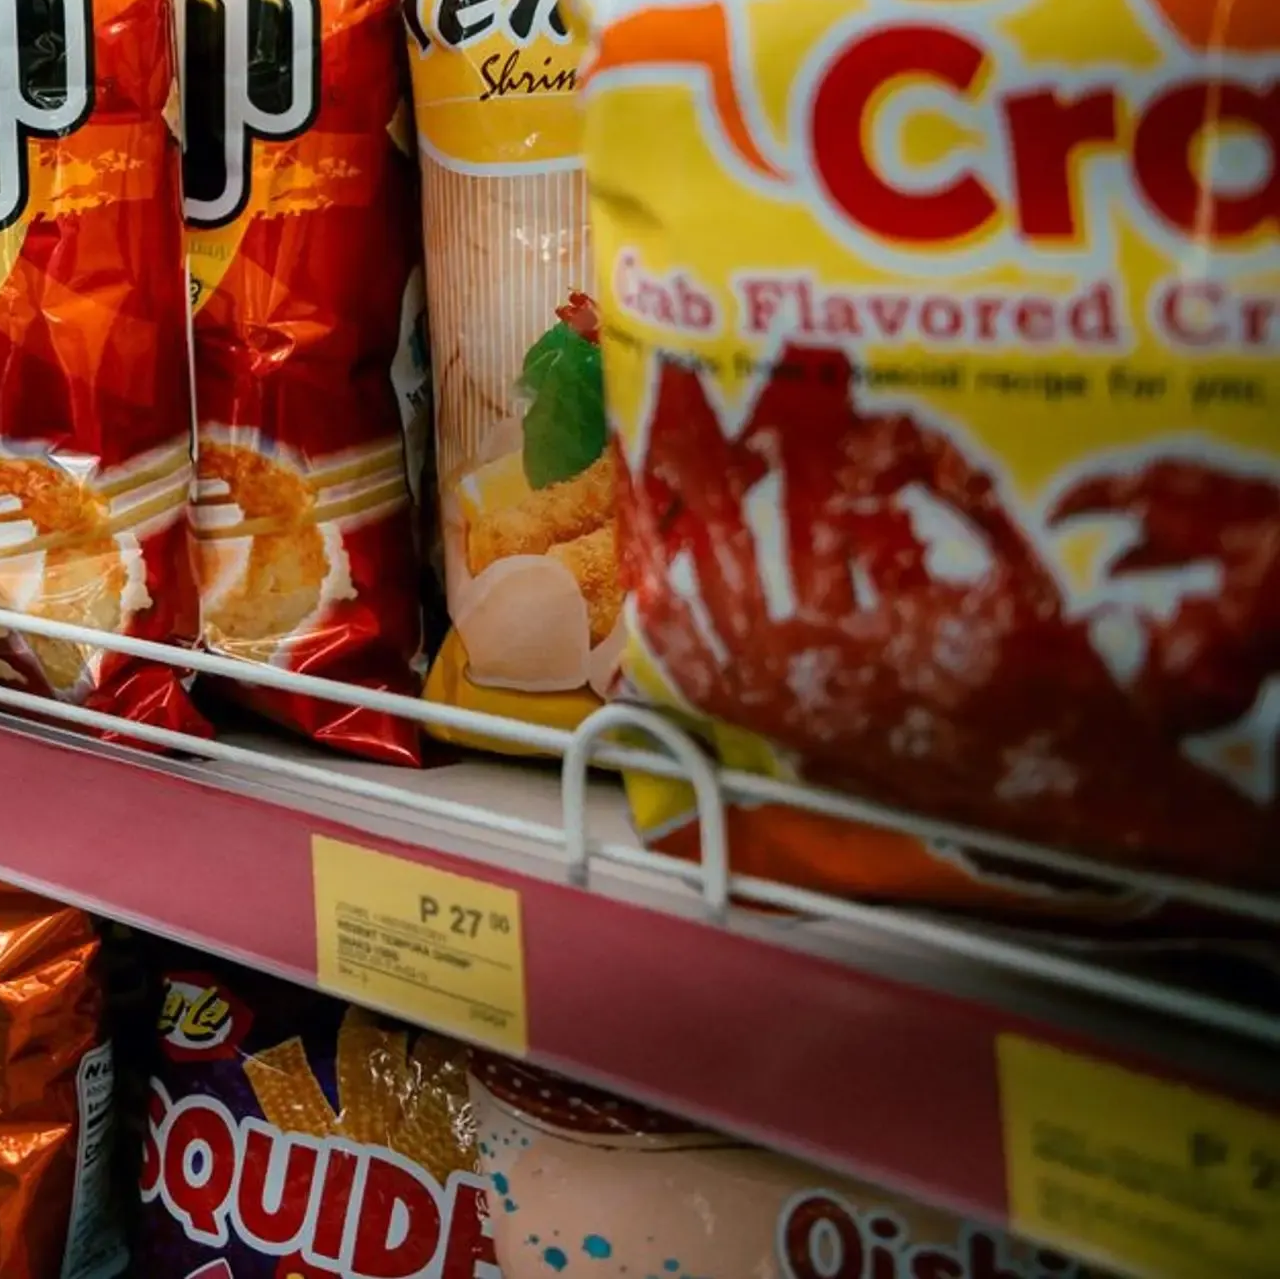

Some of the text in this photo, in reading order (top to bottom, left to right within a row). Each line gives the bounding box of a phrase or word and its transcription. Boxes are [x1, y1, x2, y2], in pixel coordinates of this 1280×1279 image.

[744, 278, 1116, 346] Flavored
[419, 893, 440, 924] P
[449, 904, 484, 941] 27
